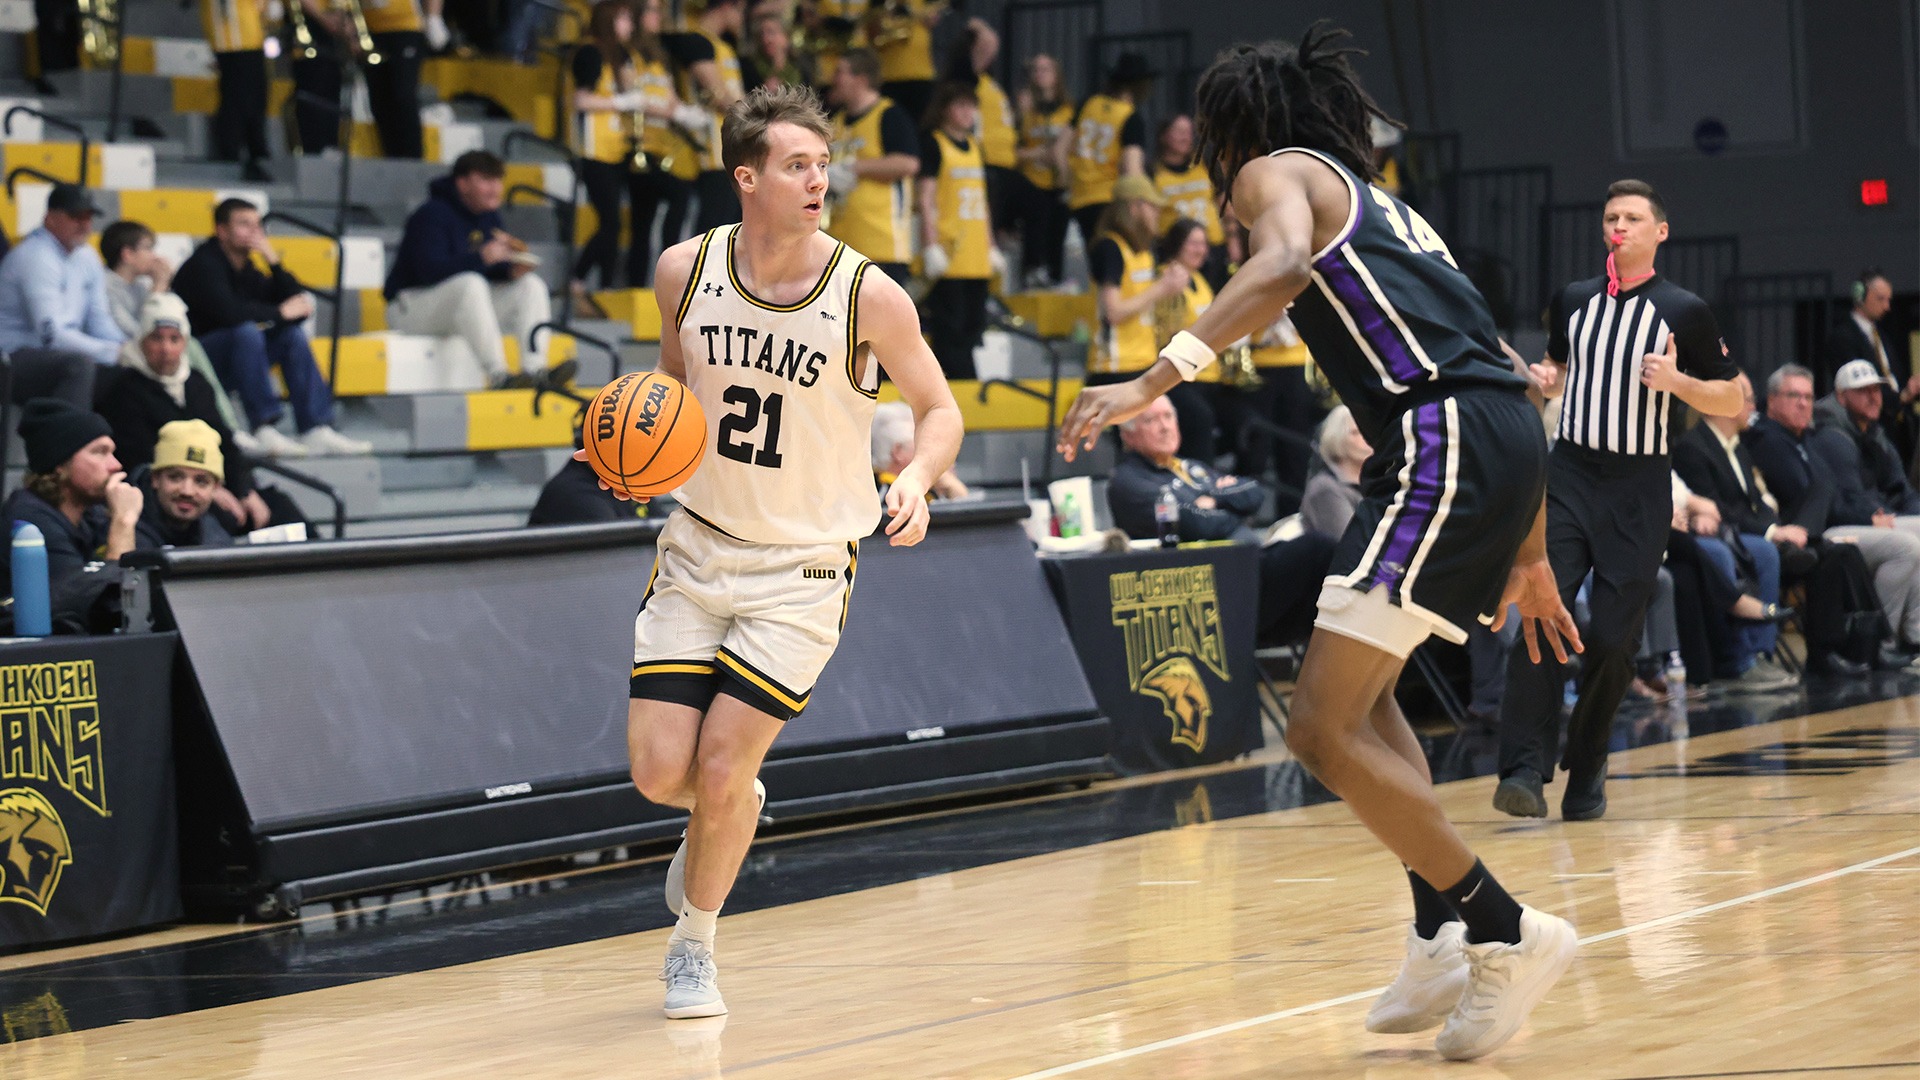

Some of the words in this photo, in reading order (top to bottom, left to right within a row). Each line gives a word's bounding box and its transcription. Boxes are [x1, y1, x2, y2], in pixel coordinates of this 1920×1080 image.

[700, 325, 827, 388] TITANS
[598, 373, 641, 442] Wilson
[635, 382, 669, 436] NCAA
[717, 384, 783, 469] 21
[803, 569, 836, 579] UWO
[1112, 598, 1231, 692] TITANS
